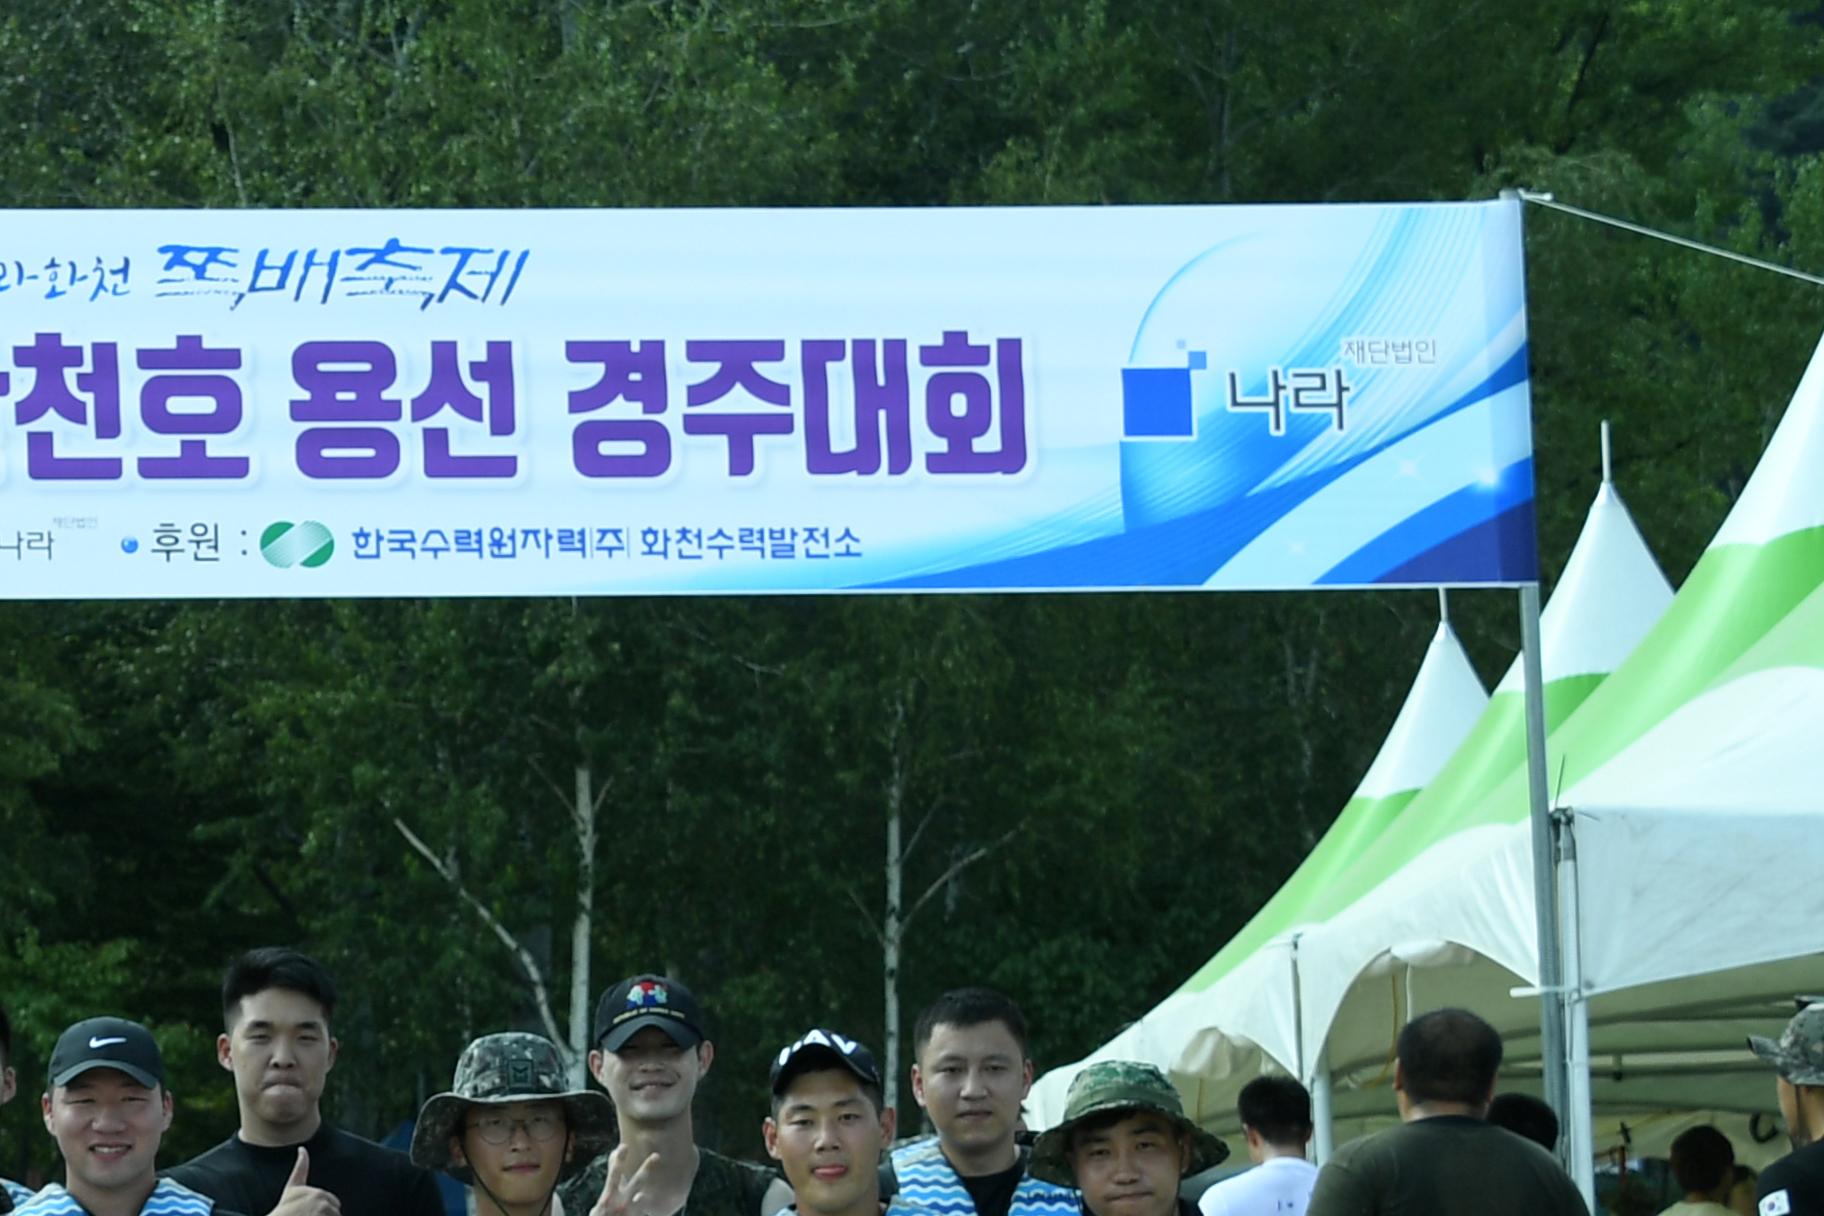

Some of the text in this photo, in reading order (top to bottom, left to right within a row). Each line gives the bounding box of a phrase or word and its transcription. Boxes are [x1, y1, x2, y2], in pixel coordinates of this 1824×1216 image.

[1343, 338, 1437, 365] 재단법인
[288, 340, 519, 480] 용선
[564, 330, 1028, 478] 경주대회
[1228, 367, 1351, 432] 나라
[150, 522, 221, 563] 후원
[639, 526, 863, 561] 화천수력발전소
